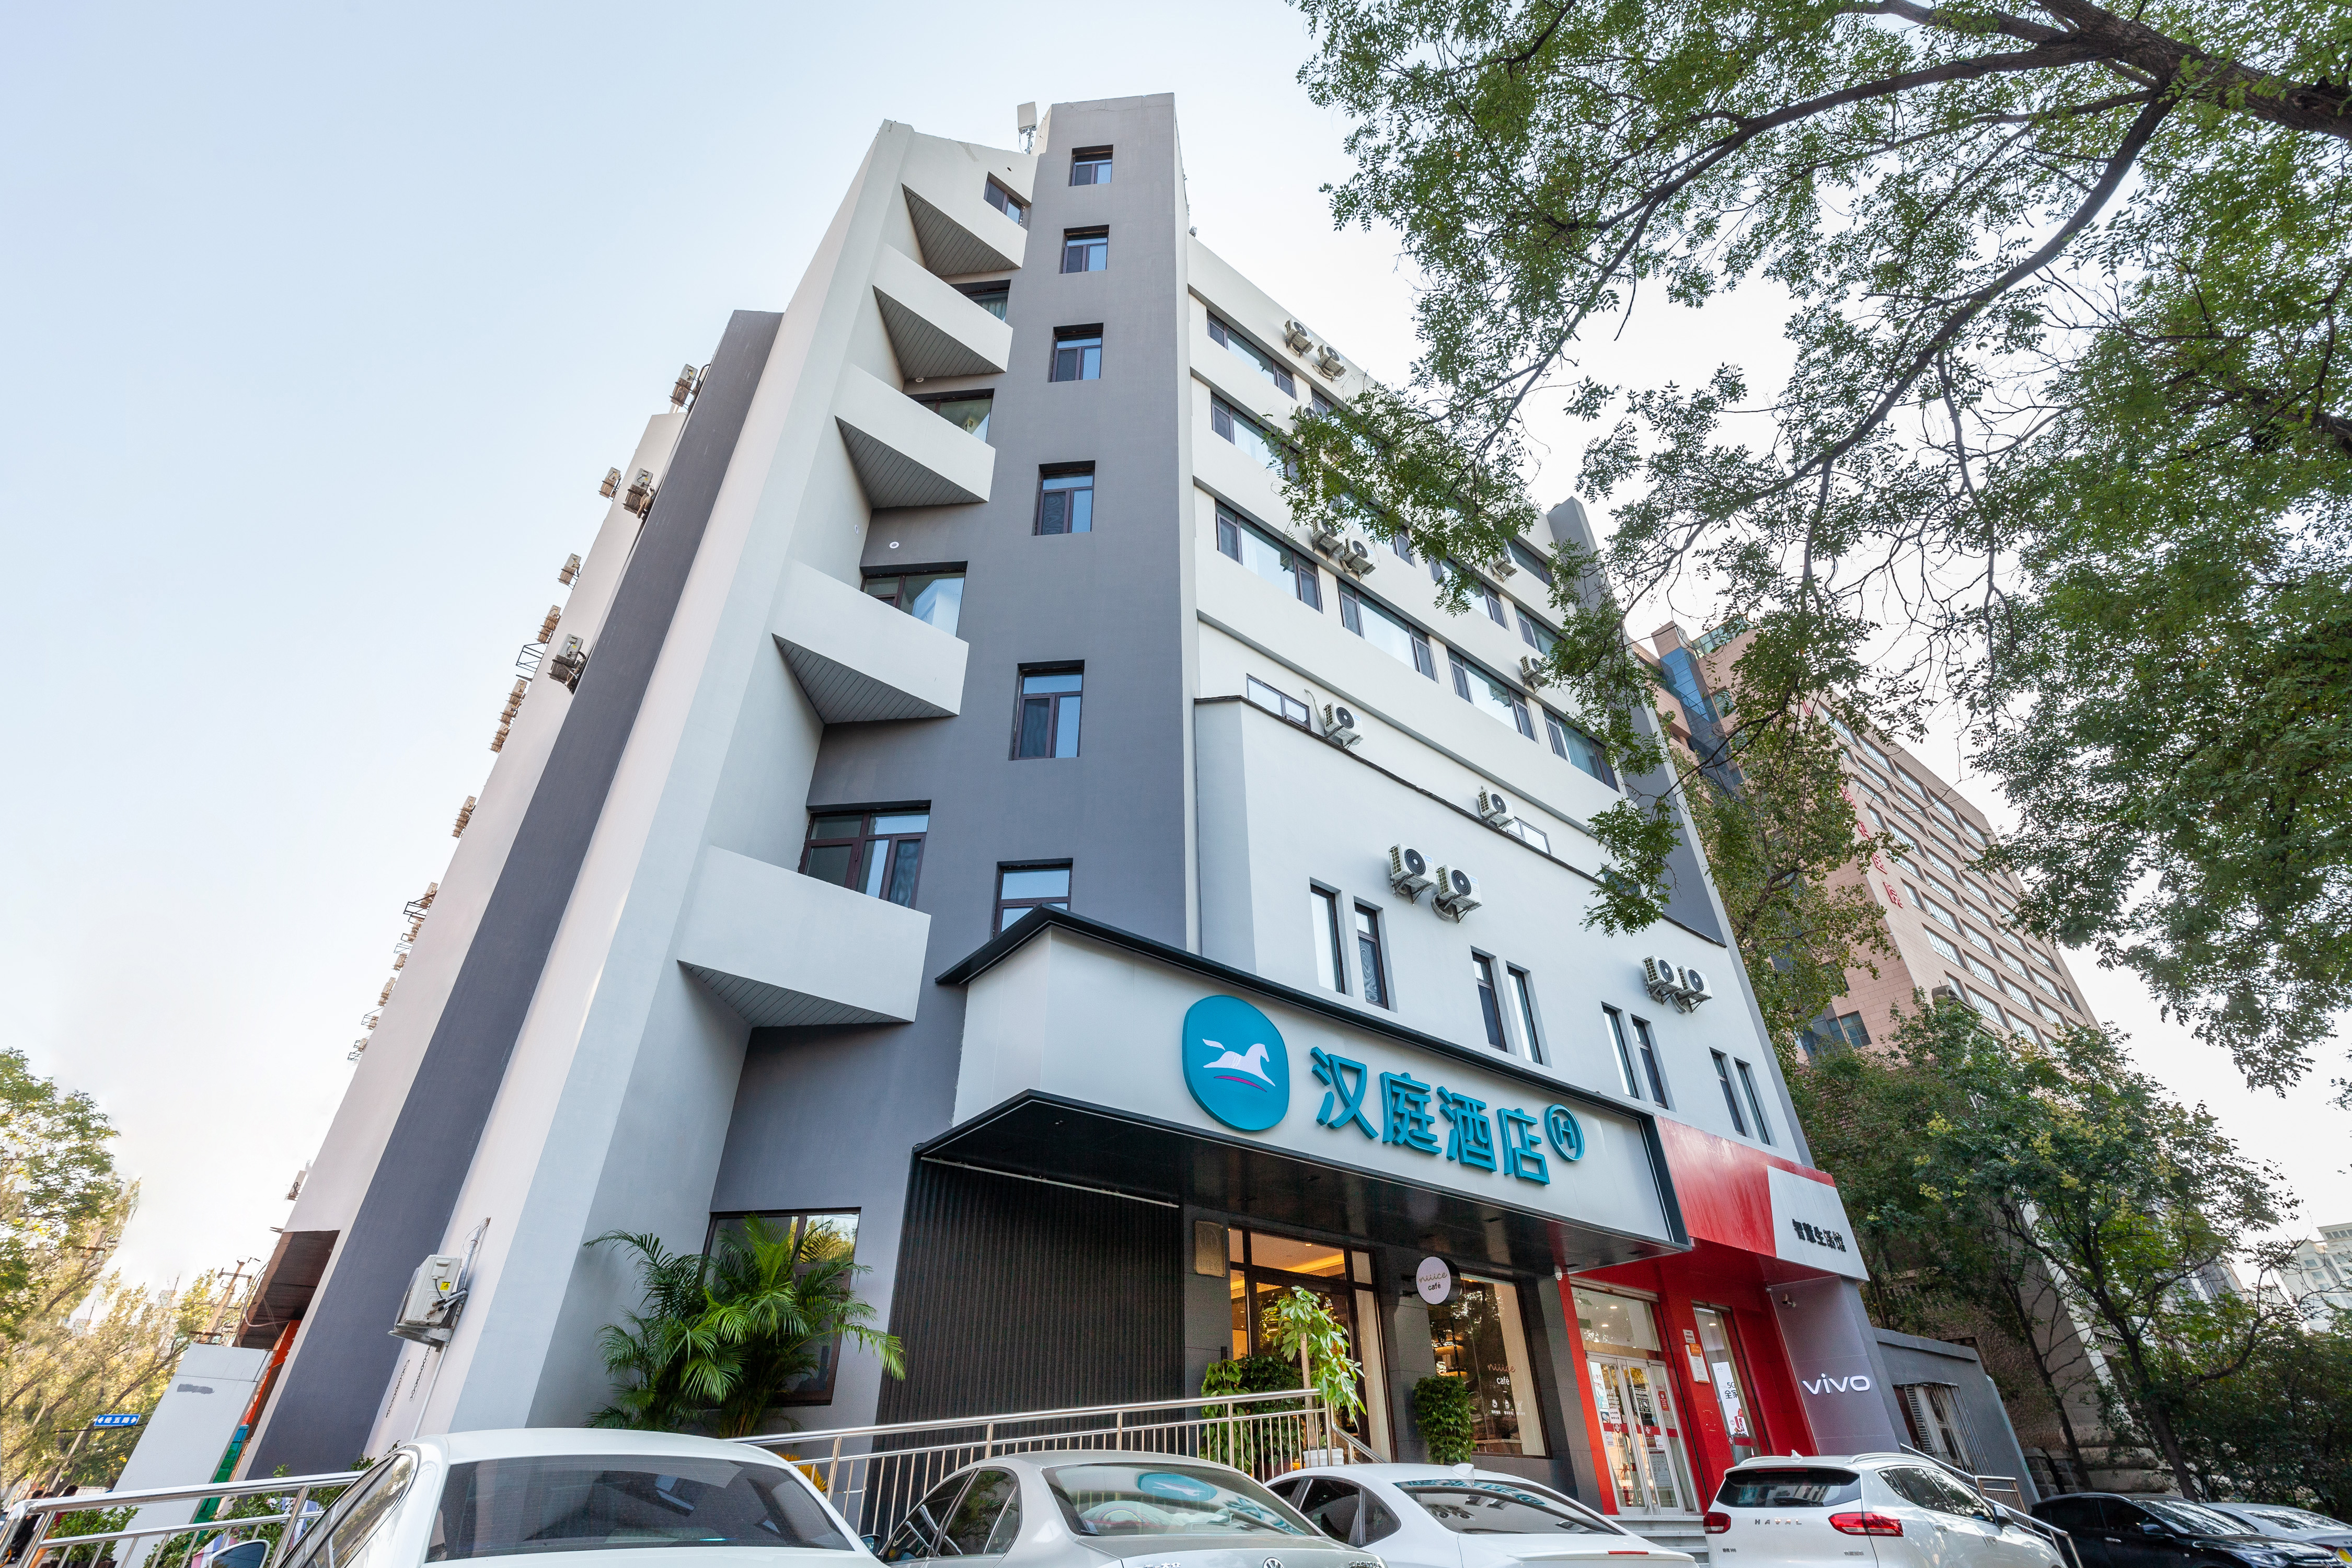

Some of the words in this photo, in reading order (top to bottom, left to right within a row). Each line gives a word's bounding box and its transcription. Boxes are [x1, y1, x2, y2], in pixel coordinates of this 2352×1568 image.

[1310, 1047, 1550, 1185] 汉庭酒店
[1428, 1282, 1441, 1290] café
[1496, 1376, 1510, 1385] café
[1802, 1373, 1871, 1394] vivo
